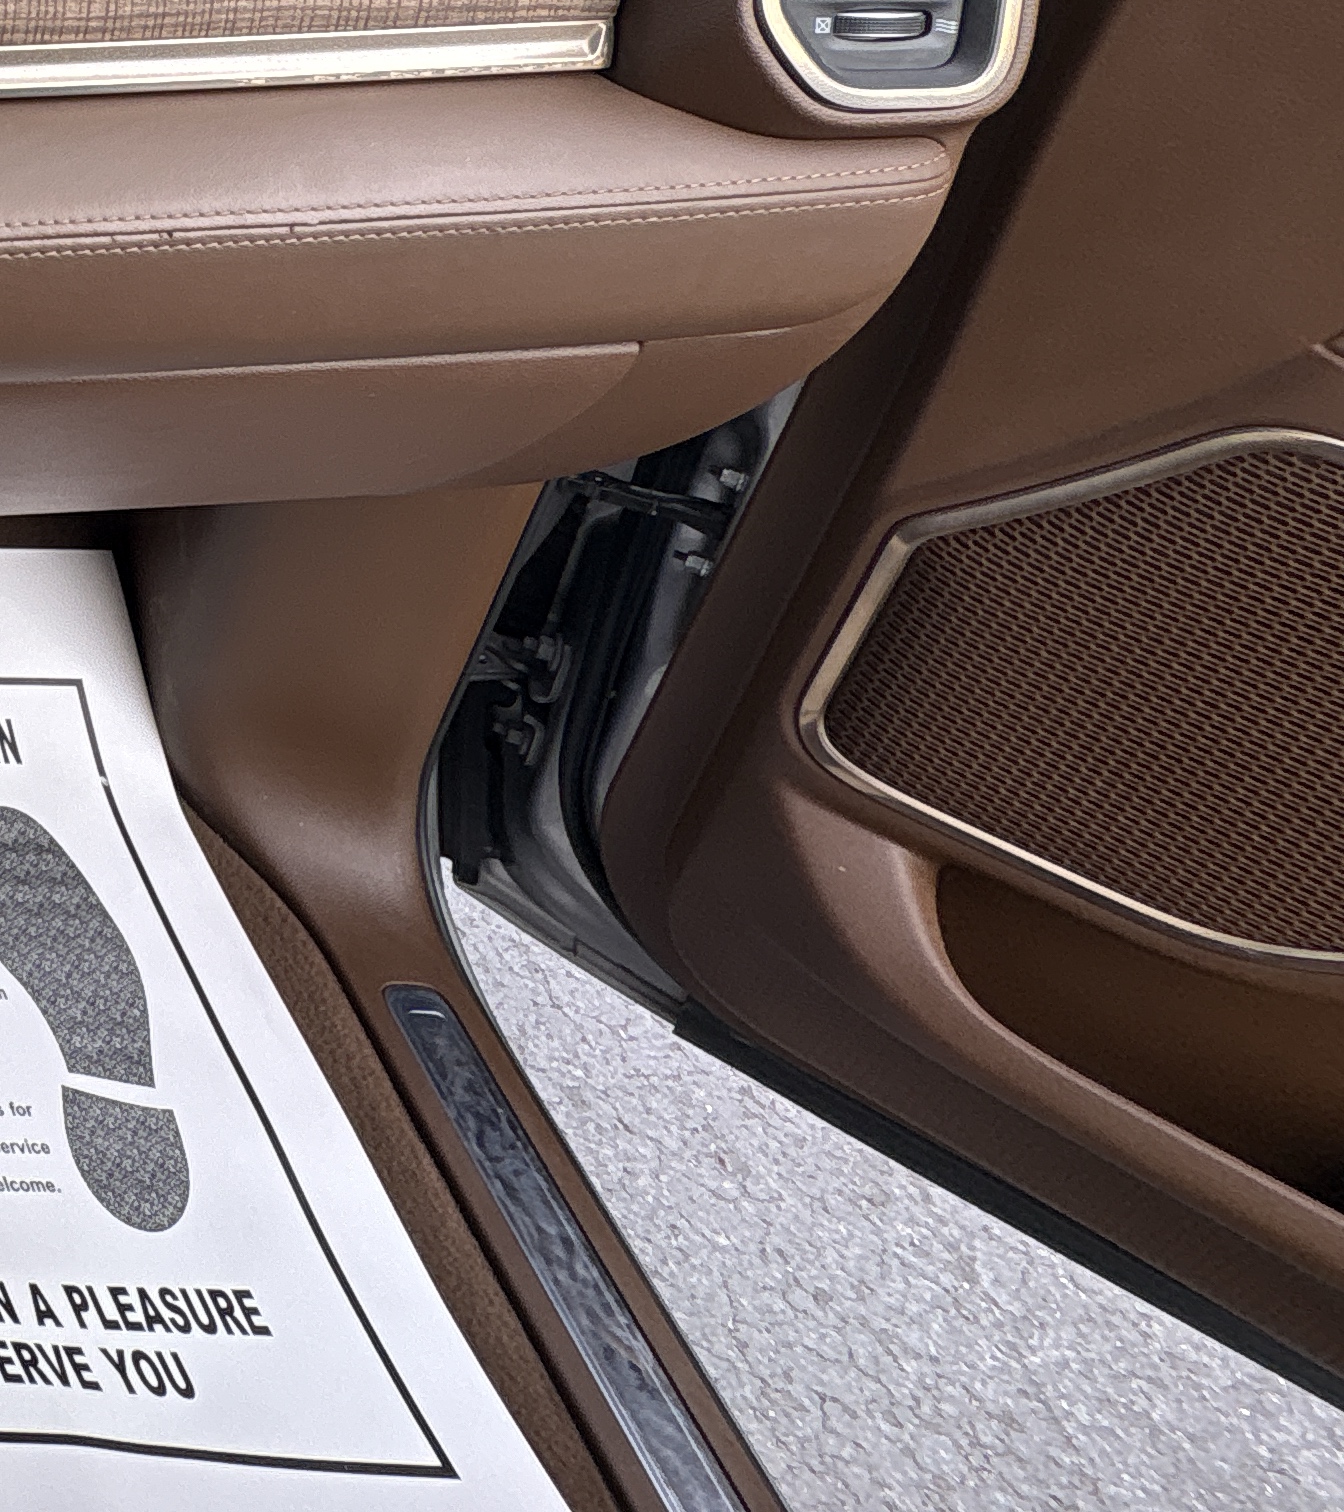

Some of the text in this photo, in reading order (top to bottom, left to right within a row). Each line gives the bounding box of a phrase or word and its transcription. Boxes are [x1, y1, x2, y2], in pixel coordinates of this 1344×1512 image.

[9, 1101, 33, 1118] for
[28, 1281, 64, 1329] A
[61, 1284, 274, 1338] PLEASURE
[97, 1346, 196, 1400] YOU
